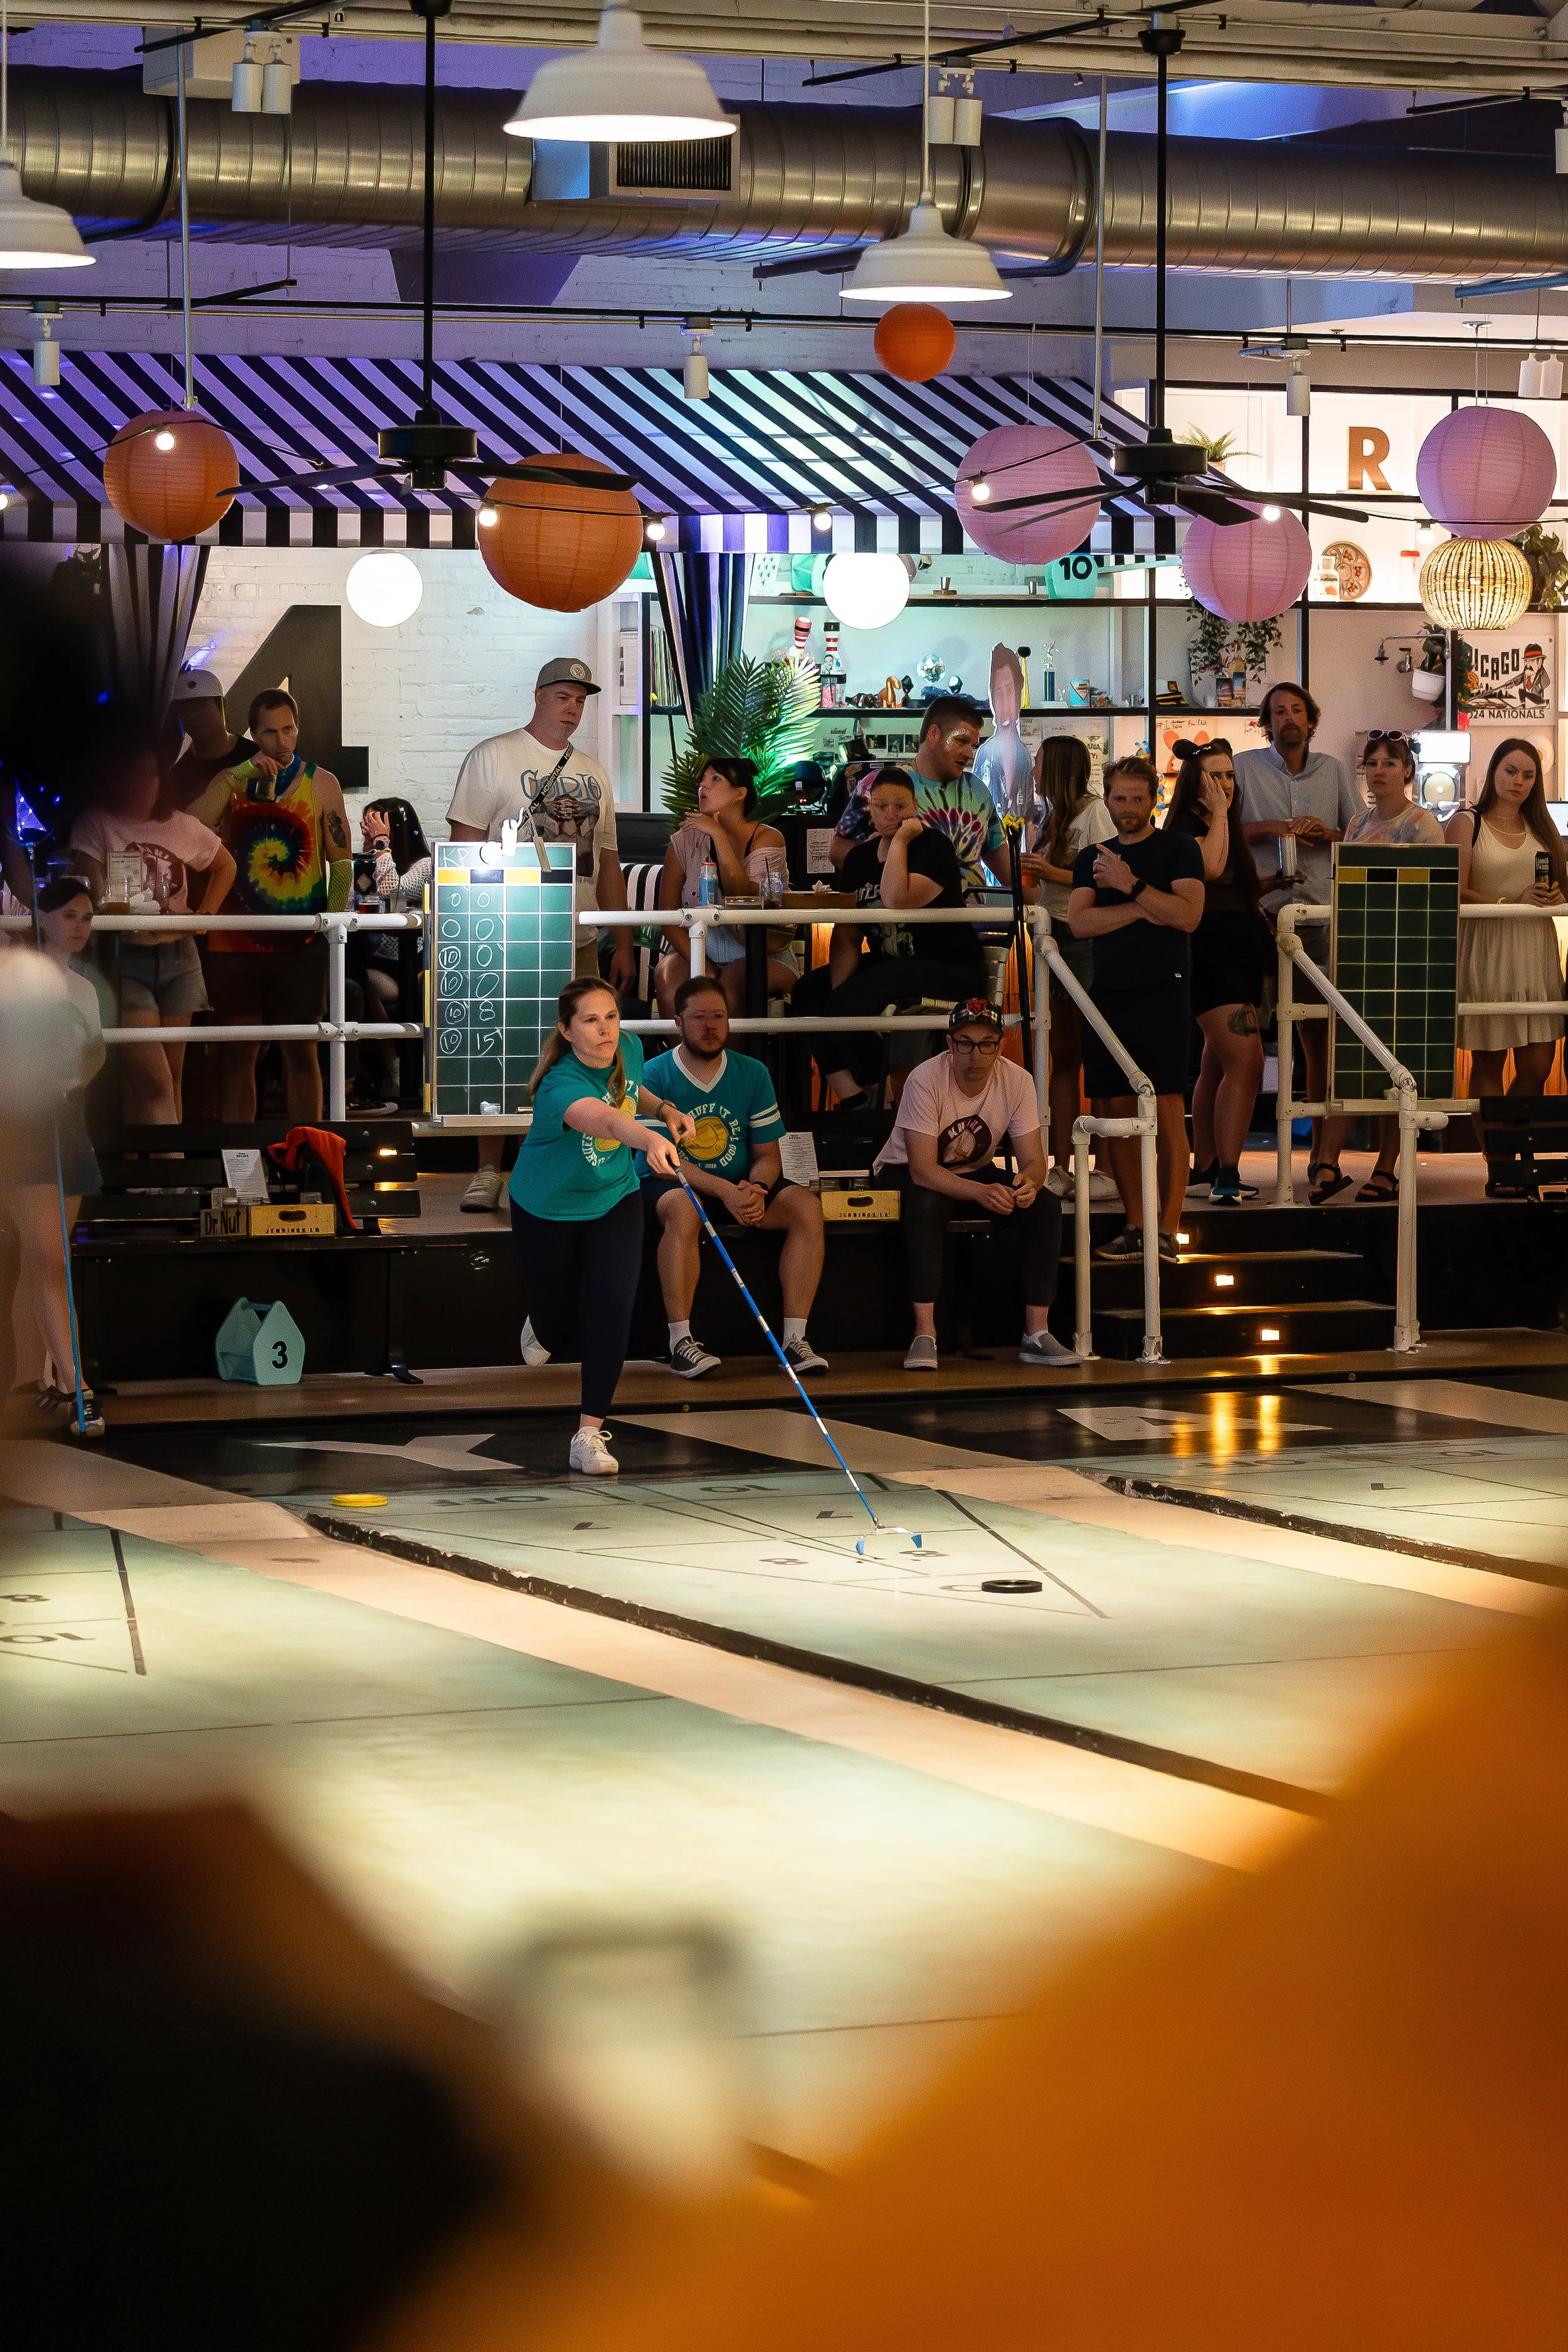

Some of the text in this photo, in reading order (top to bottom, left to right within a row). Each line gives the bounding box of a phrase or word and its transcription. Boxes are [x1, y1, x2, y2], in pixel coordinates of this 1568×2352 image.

[1347, 426, 1392, 490] R
[1059, 556, 1093, 580] 10
[1469, 648, 1520, 681] ICAGO
[219, 605, 369, 787] 4
[1468, 710, 1545, 719] 24 NATIONALS
[541, 765, 563, 796] HOSPITAL
[450, 892, 490, 908] 0 0
[442, 918, 495, 940] 0 0
[476, 945, 492, 967] 0
[475, 972, 500, 999] 0
[479, 1000, 495, 1022] 8
[477, 1029, 501, 1056] 15
[220, 1210, 241, 1234] Nut
[272, 1341, 289, 1369] 3
